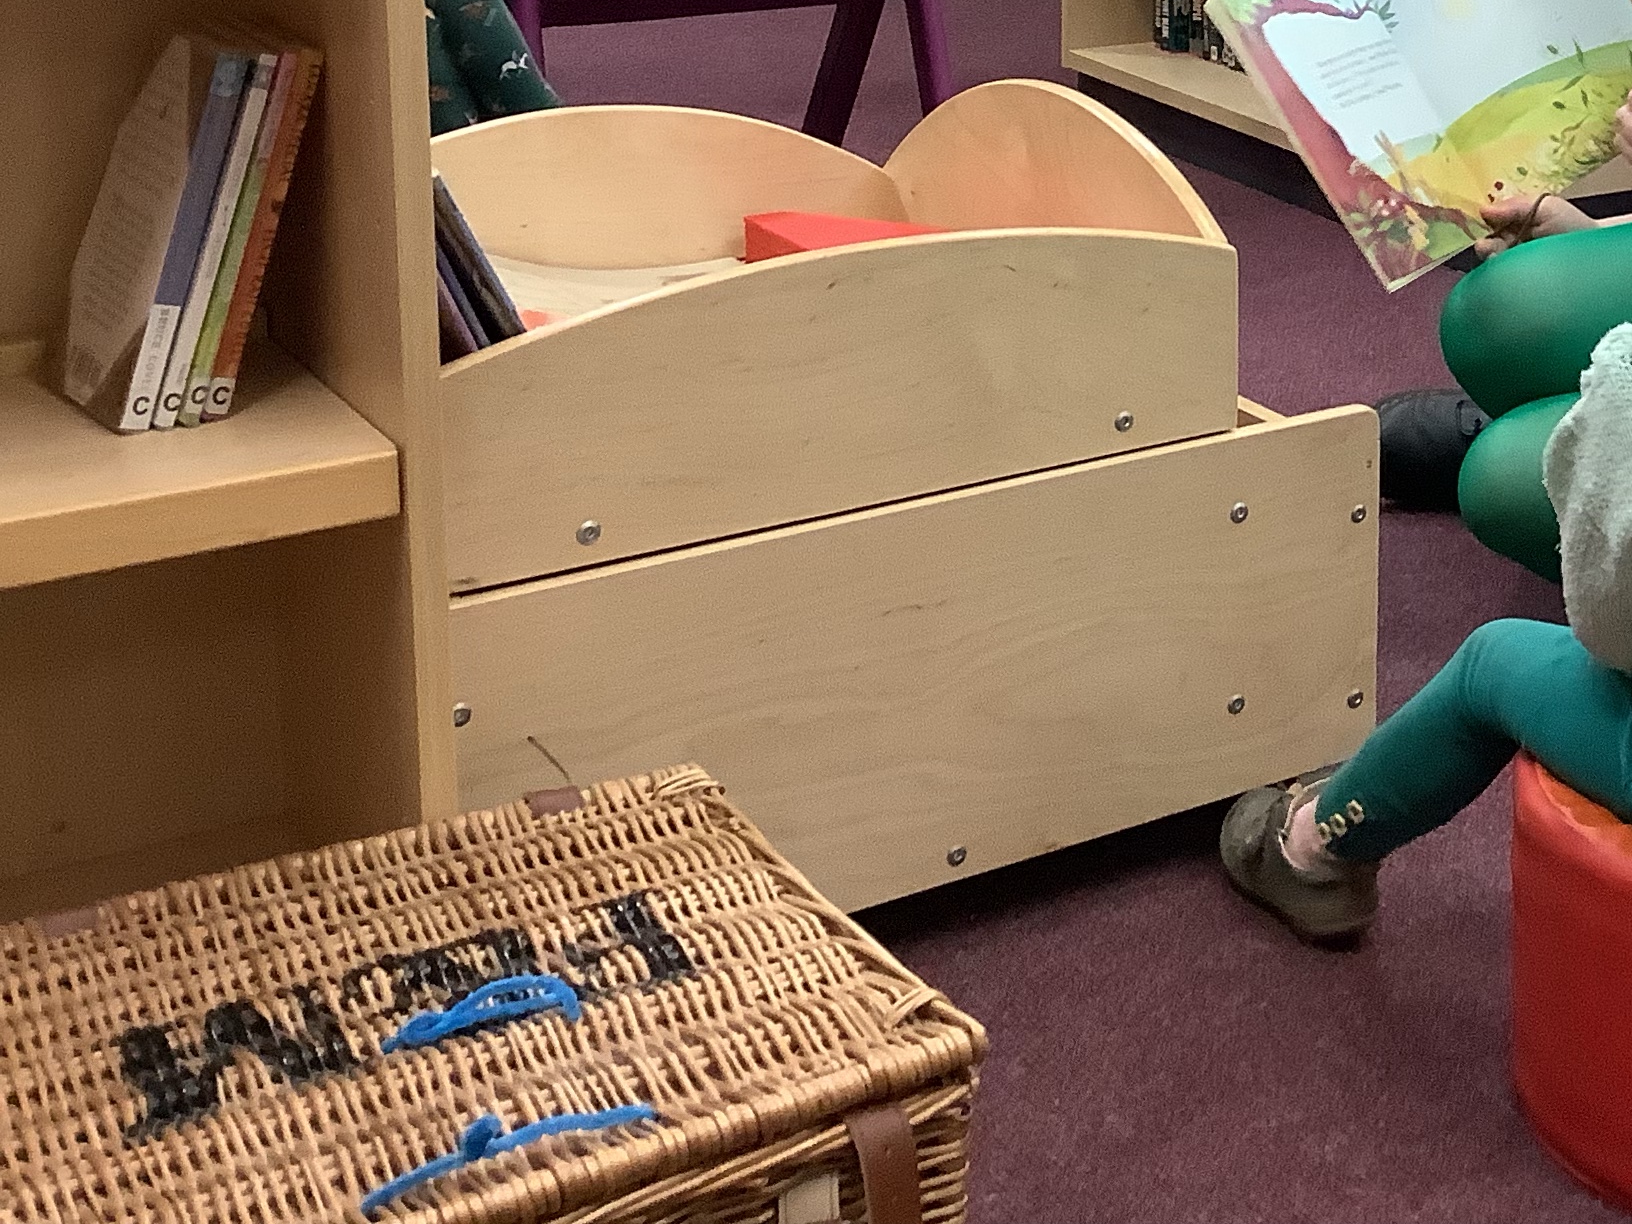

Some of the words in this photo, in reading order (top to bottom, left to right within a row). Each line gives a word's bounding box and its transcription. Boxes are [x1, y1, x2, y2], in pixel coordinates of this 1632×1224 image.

[163, 392, 181, 412] C
[191, 385, 210, 405] C
[212, 386, 230, 405] C
[133, 396, 150, 416] C
